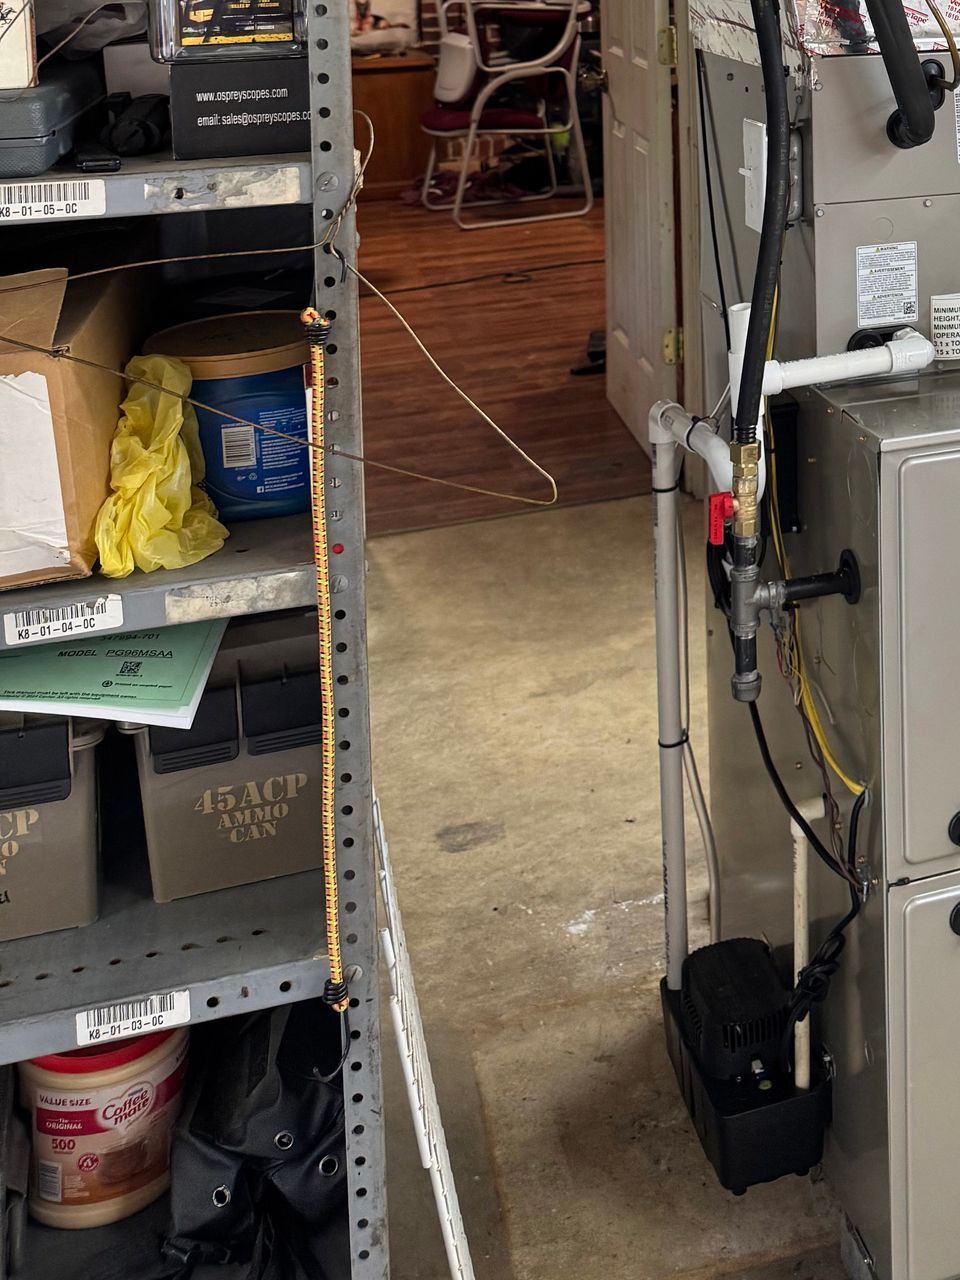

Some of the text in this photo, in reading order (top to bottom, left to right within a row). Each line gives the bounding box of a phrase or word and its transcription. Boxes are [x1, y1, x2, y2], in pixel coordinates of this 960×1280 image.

[196, 87, 288, 103] www.ospreyscopes.com
[197, 109, 311, 126] email: sales@ospreyscopes.co
[17, 618, 96, 640] K8-01-04-0C
[57, 649, 173, 658] MODEL PG96MSAA
[217, 802, 289, 830] AMMO
[229, 820, 279, 843] CAN
[88, 1014, 164, 1040] K8-01-03-0C
[39, 1094, 92, 1106] VALUE SIZE
[102, 1088, 149, 1121] Coffee
[113, 1097, 151, 1125] mate
[52, 1138, 76, 1150] 500
